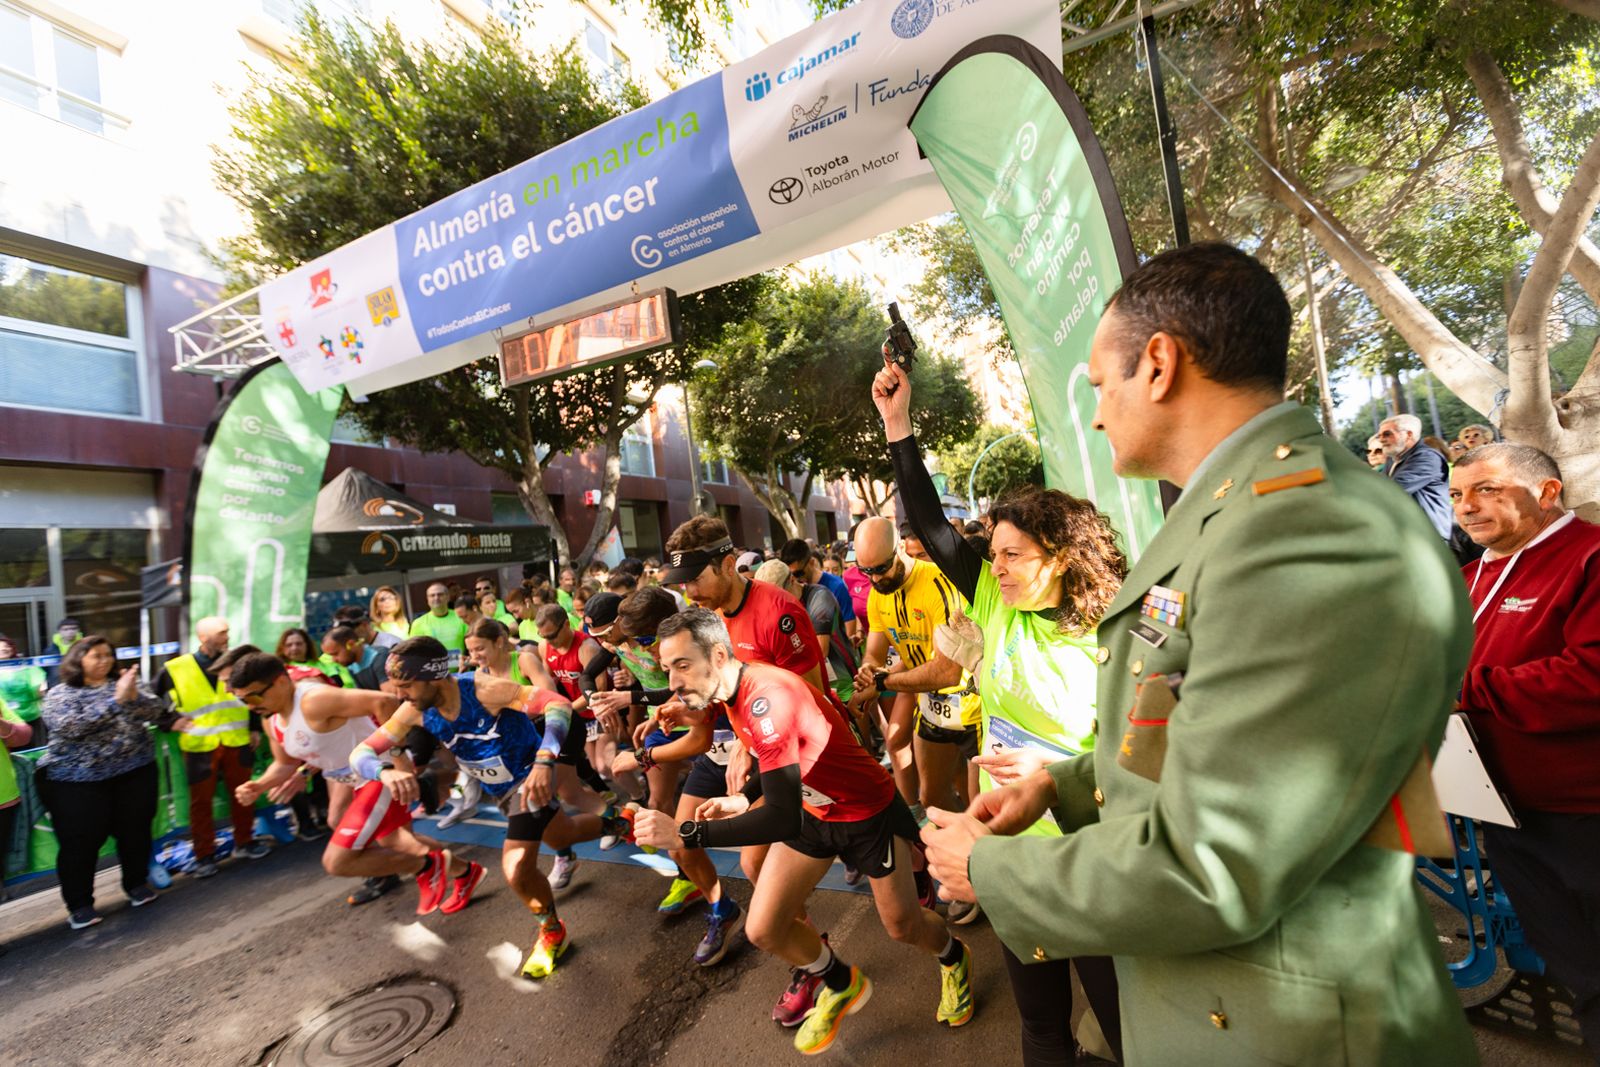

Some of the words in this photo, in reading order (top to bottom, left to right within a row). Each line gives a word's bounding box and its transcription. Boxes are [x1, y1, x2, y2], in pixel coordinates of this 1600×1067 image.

[777, 31, 861, 84] cajamar
[868, 68, 932, 106] Funda
[788, 109, 847, 142] MICHELIN
[413, 190, 516, 257] Almería
[523, 172, 561, 206] en
[571, 111, 700, 189] marcha
[805, 154, 850, 179] Toyota
[811, 169, 861, 194] Alborán
[862, 151, 900, 172] Motor
[418, 244, 506, 297] contra
[511, 221, 542, 260] el
[546, 176, 659, 245] cáncer
[657, 218, 701, 239] asociación
[701, 203, 738, 222] española
[664, 234, 689, 248] contra
[689, 229, 698, 239] el
[698, 220, 725, 235] cáncer
[668, 249, 680, 257] en
[680, 237, 712, 253] Almería
